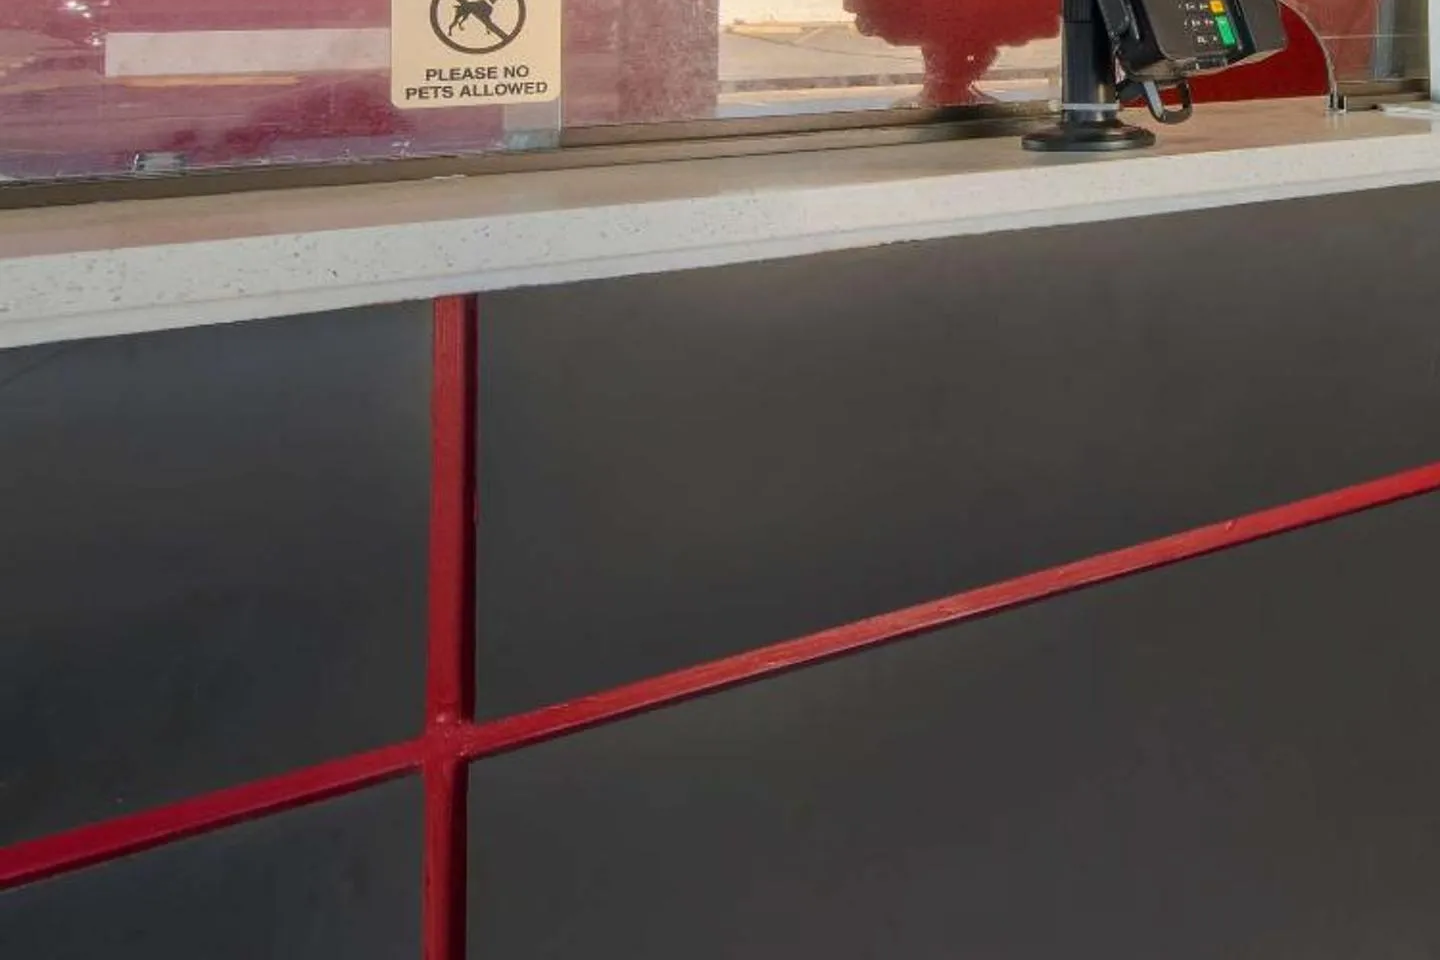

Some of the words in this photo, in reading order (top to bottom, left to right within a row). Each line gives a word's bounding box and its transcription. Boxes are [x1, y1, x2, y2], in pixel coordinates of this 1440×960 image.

[425, 65, 499, 82] PLEASE
[503, 64, 530, 78] NO
[405, 85, 454, 100] PETS
[459, 81, 548, 98] ALLOWED
